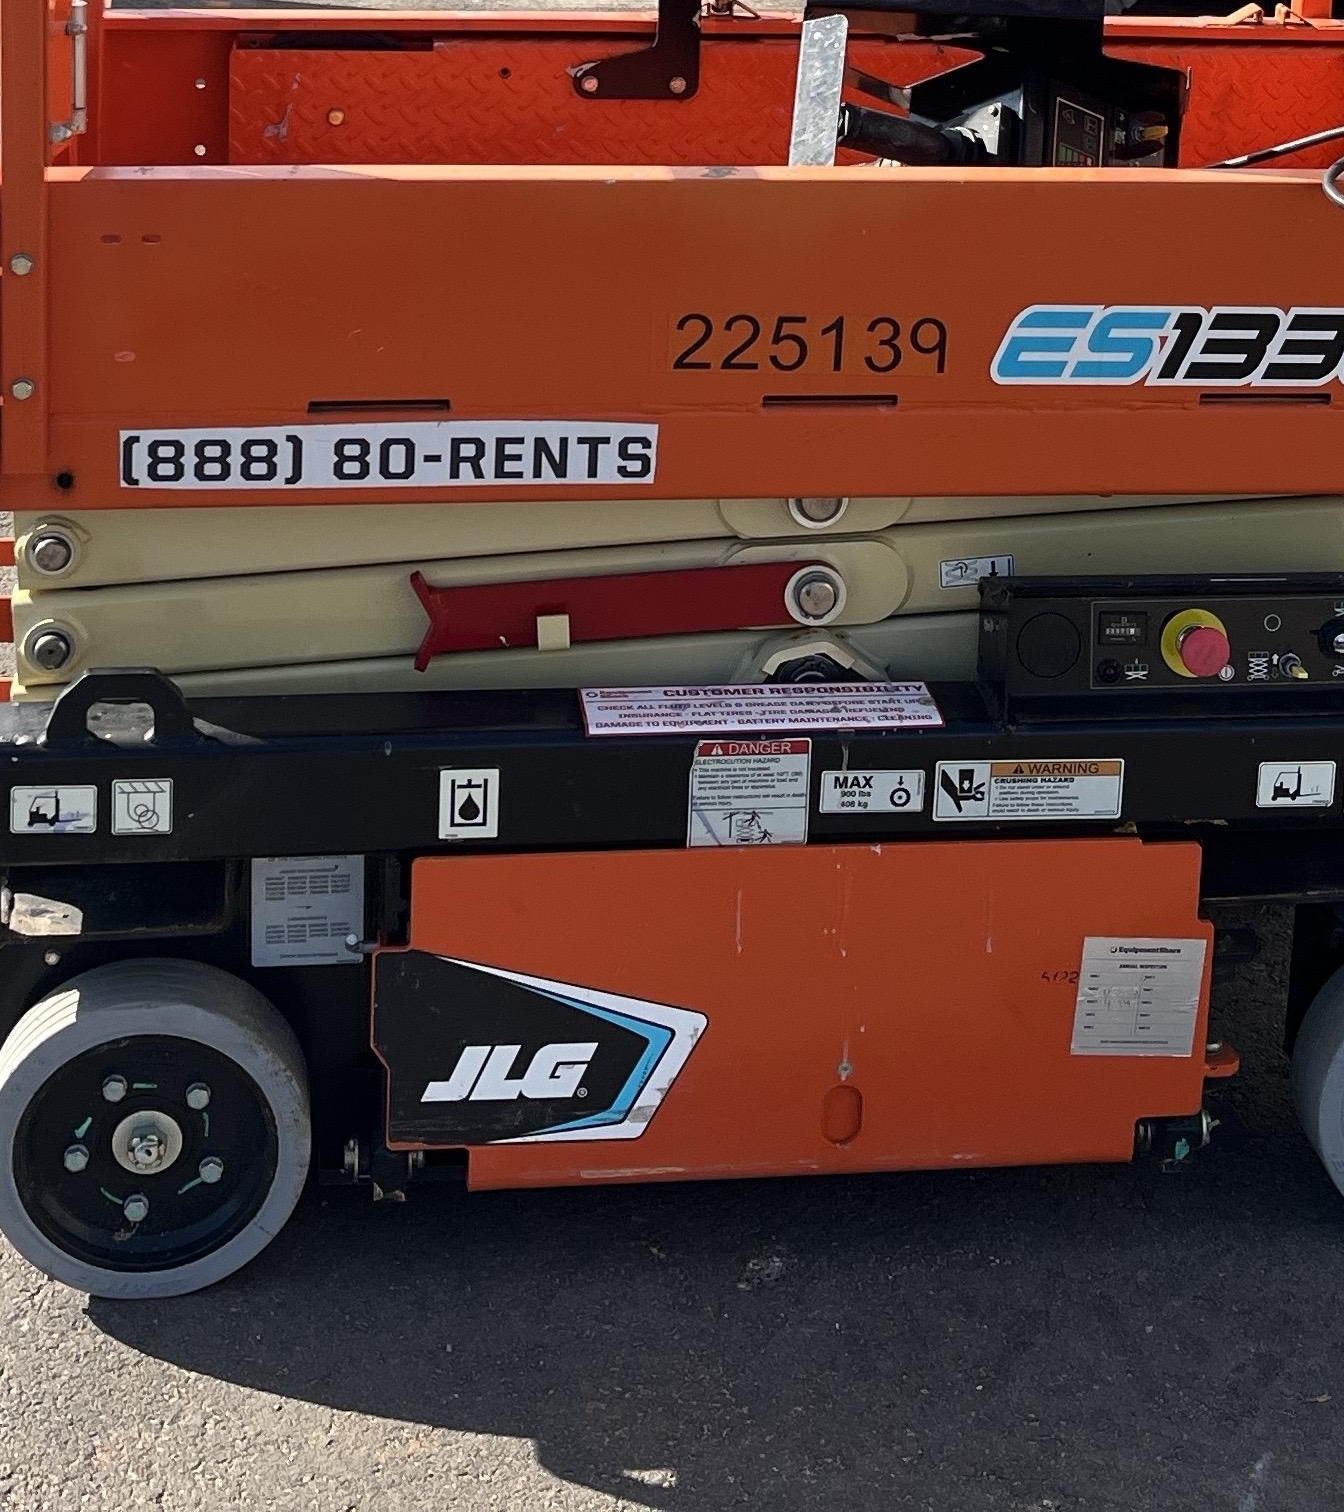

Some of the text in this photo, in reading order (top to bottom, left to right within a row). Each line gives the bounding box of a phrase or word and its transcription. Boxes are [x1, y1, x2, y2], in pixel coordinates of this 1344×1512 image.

[673, 313, 947, 374] 225139
[121, 434, 653, 486] (888) 80-RENTS
[663, 687, 765, 698] CUSTOMER
[769, 685, 924, 695] RESPONSIBILITY
[595, 721, 643, 729] DAMAGE
[662, 719, 728, 727] EQUIPMENT
[737, 717, 785, 725] BATTERY
[788, 716, 867, 724] MAINTENANCE
[728, 742, 792, 755] DANGER
[1027, 763, 1100, 775] WARNING
[833, 775, 874, 789] MAX
[1040, 776, 1075, 784] HAZARD
[858, 790, 872, 798] lbs
[857, 800, 869, 809] kg
[421, 1042, 599, 1102] JLG
